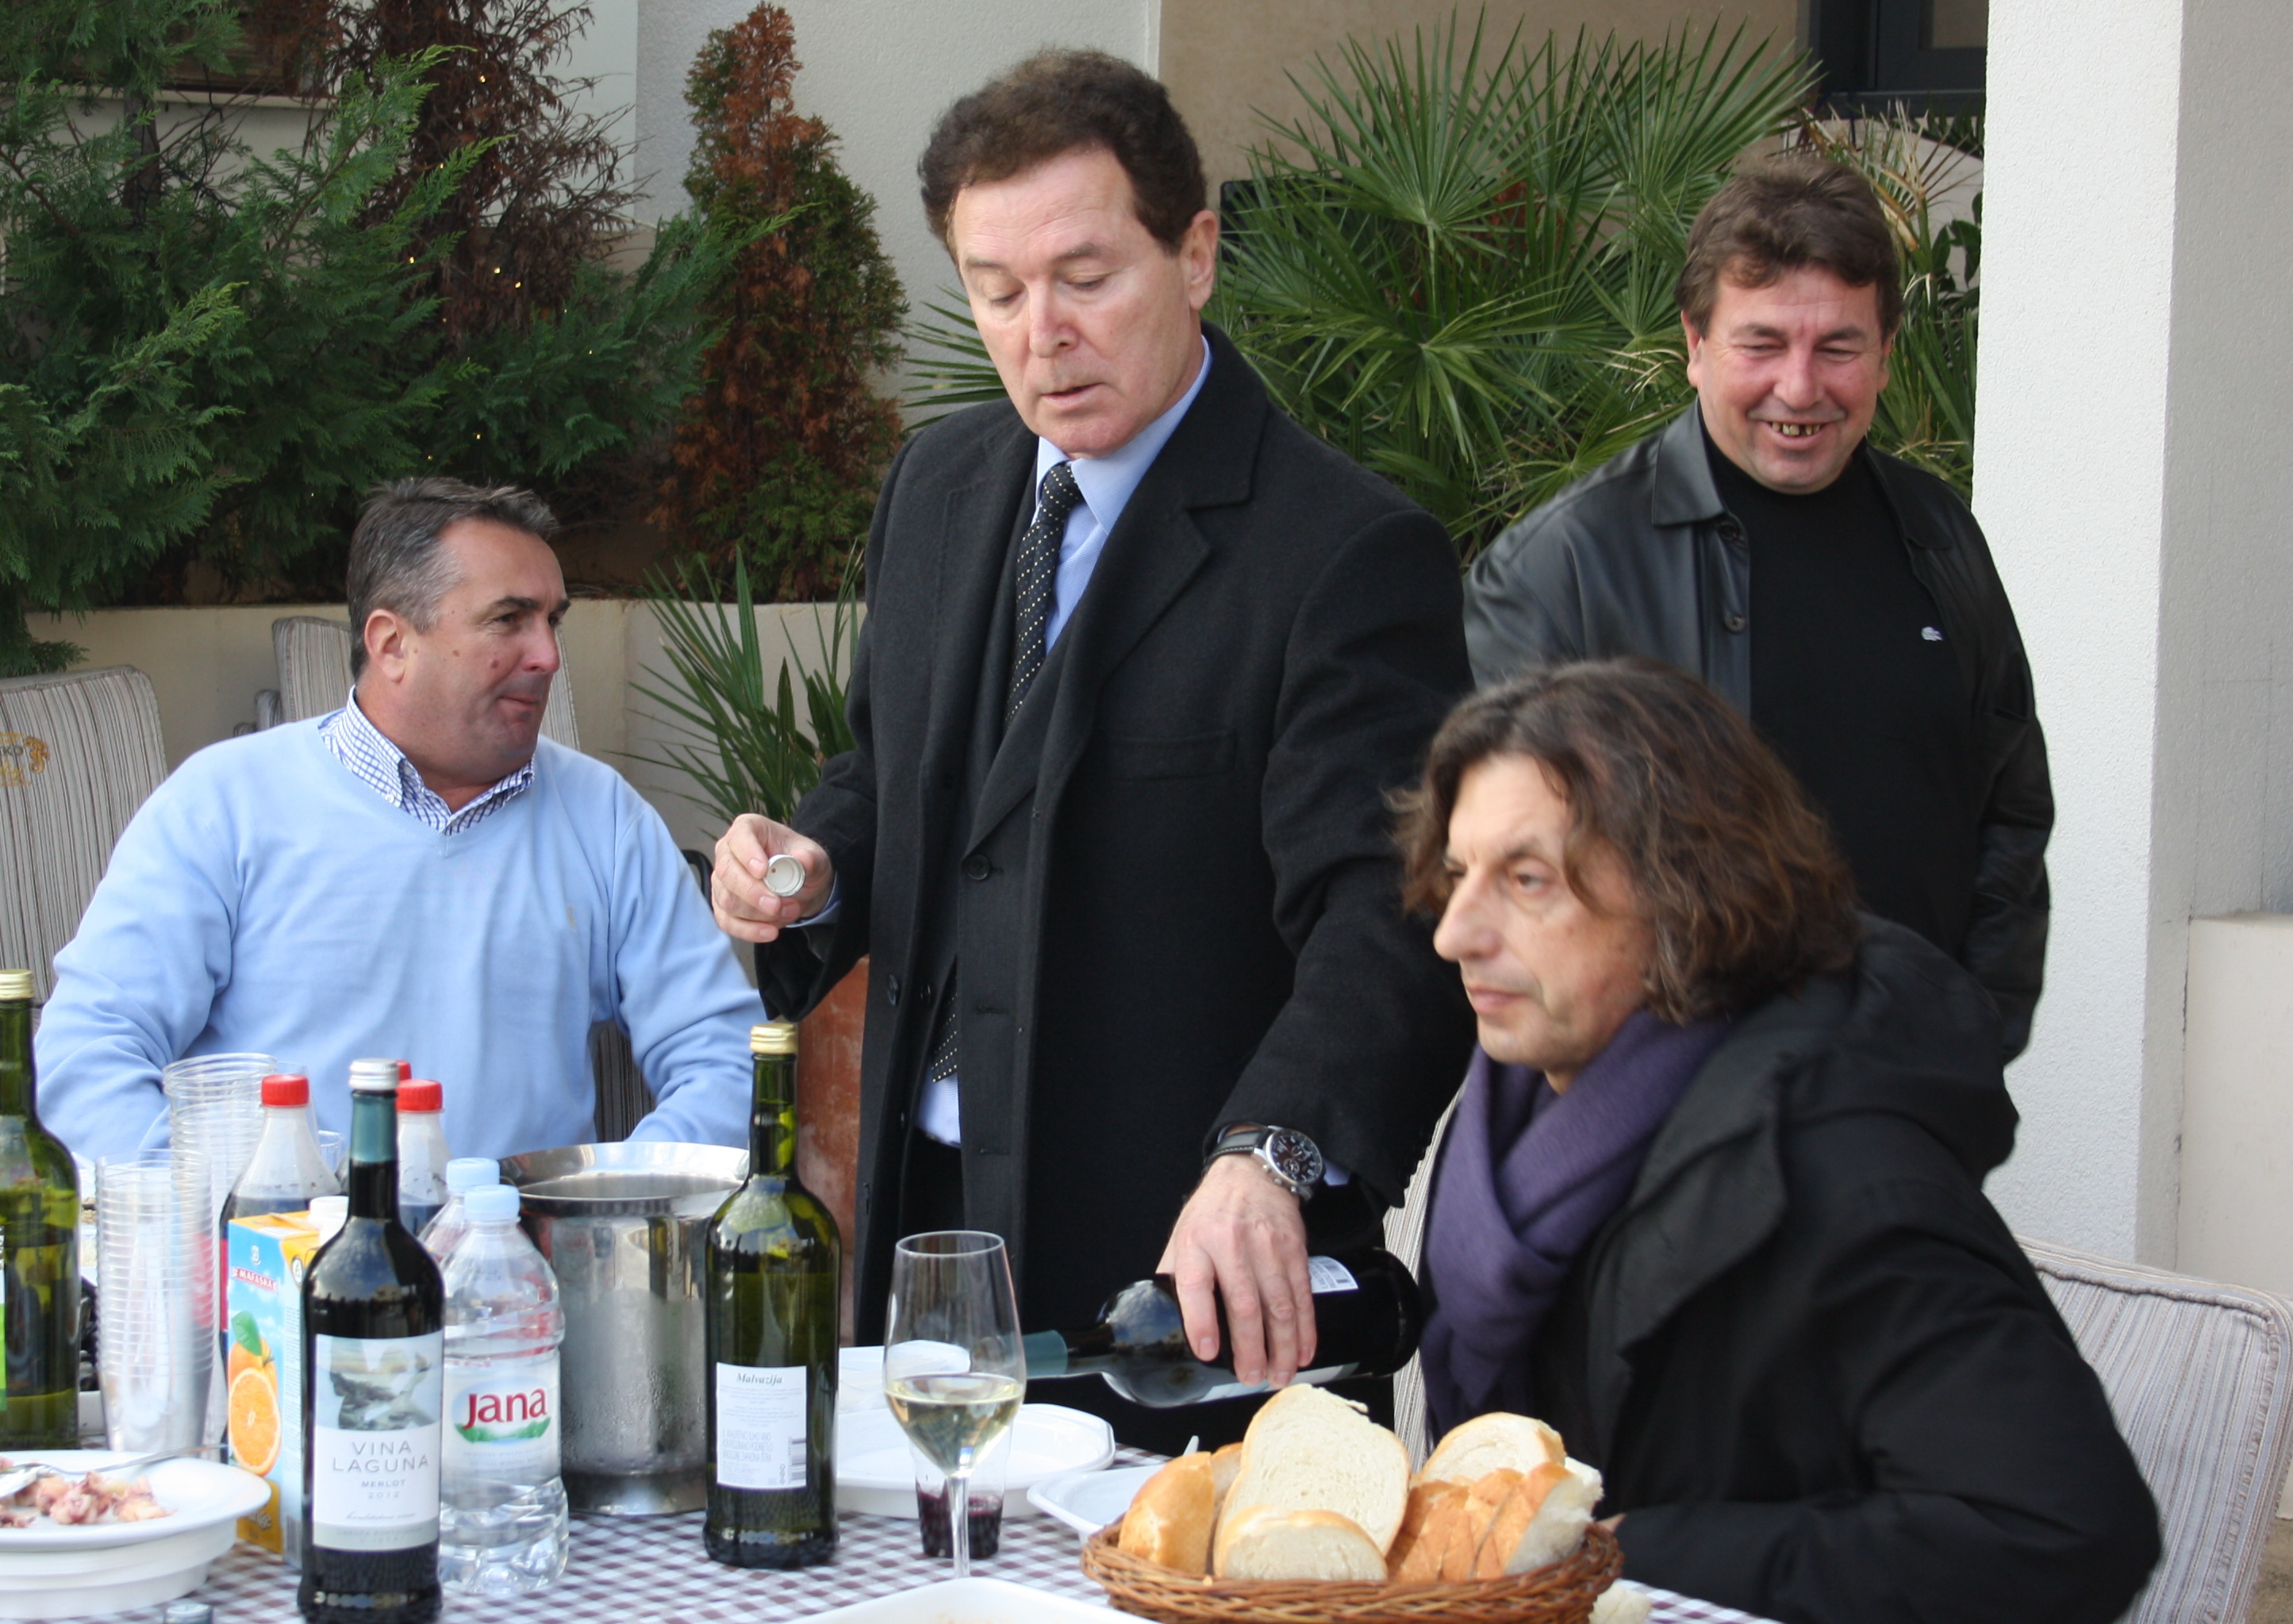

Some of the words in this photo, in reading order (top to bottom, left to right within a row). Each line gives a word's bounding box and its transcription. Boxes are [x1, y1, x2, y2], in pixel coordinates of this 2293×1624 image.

[736, 1373, 782, 1386] Malvazija
[352, 1440, 412, 1456] VINA
[332, 1453, 429, 1473] LAGUNA
[361, 1479, 406, 1488] MERLOT
[368, 1491, 400, 1499] 2012
